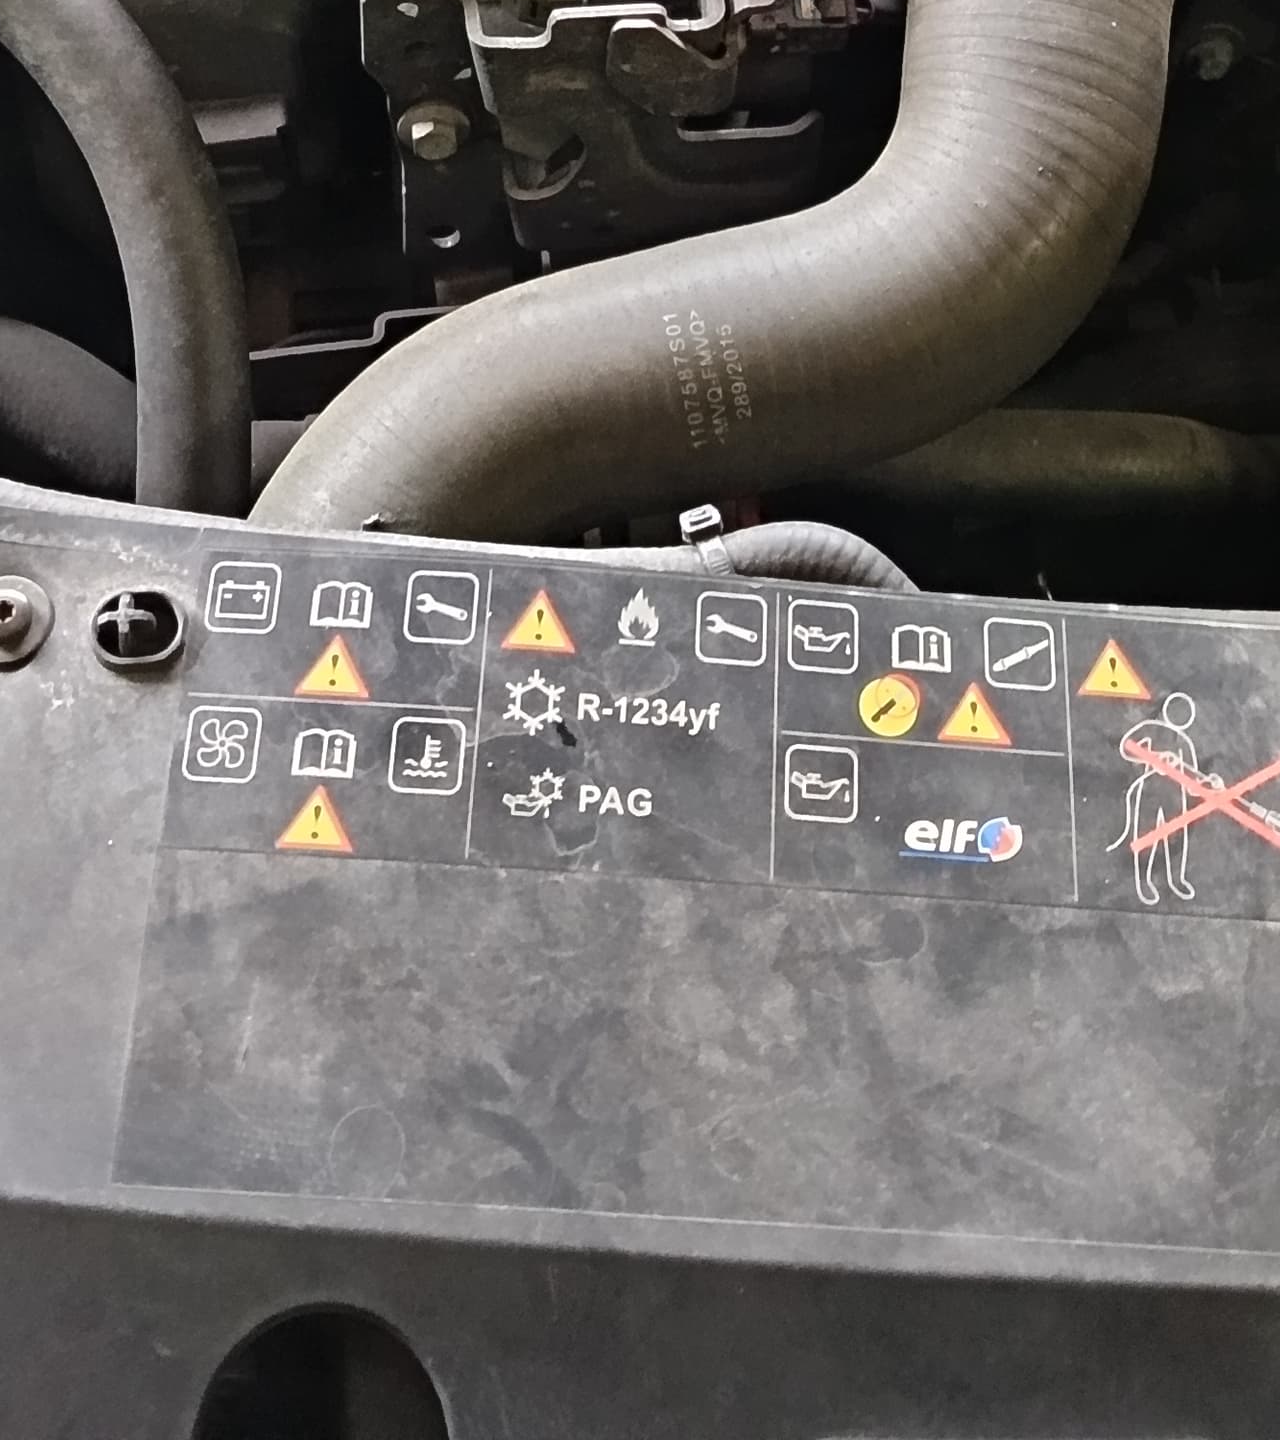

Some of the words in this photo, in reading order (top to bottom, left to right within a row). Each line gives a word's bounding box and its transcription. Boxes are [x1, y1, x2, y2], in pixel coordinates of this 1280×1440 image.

[576, 692, 721, 737] R-1234yf
[577, 783, 654, 818] PAG
[903, 817, 978, 854] elf
